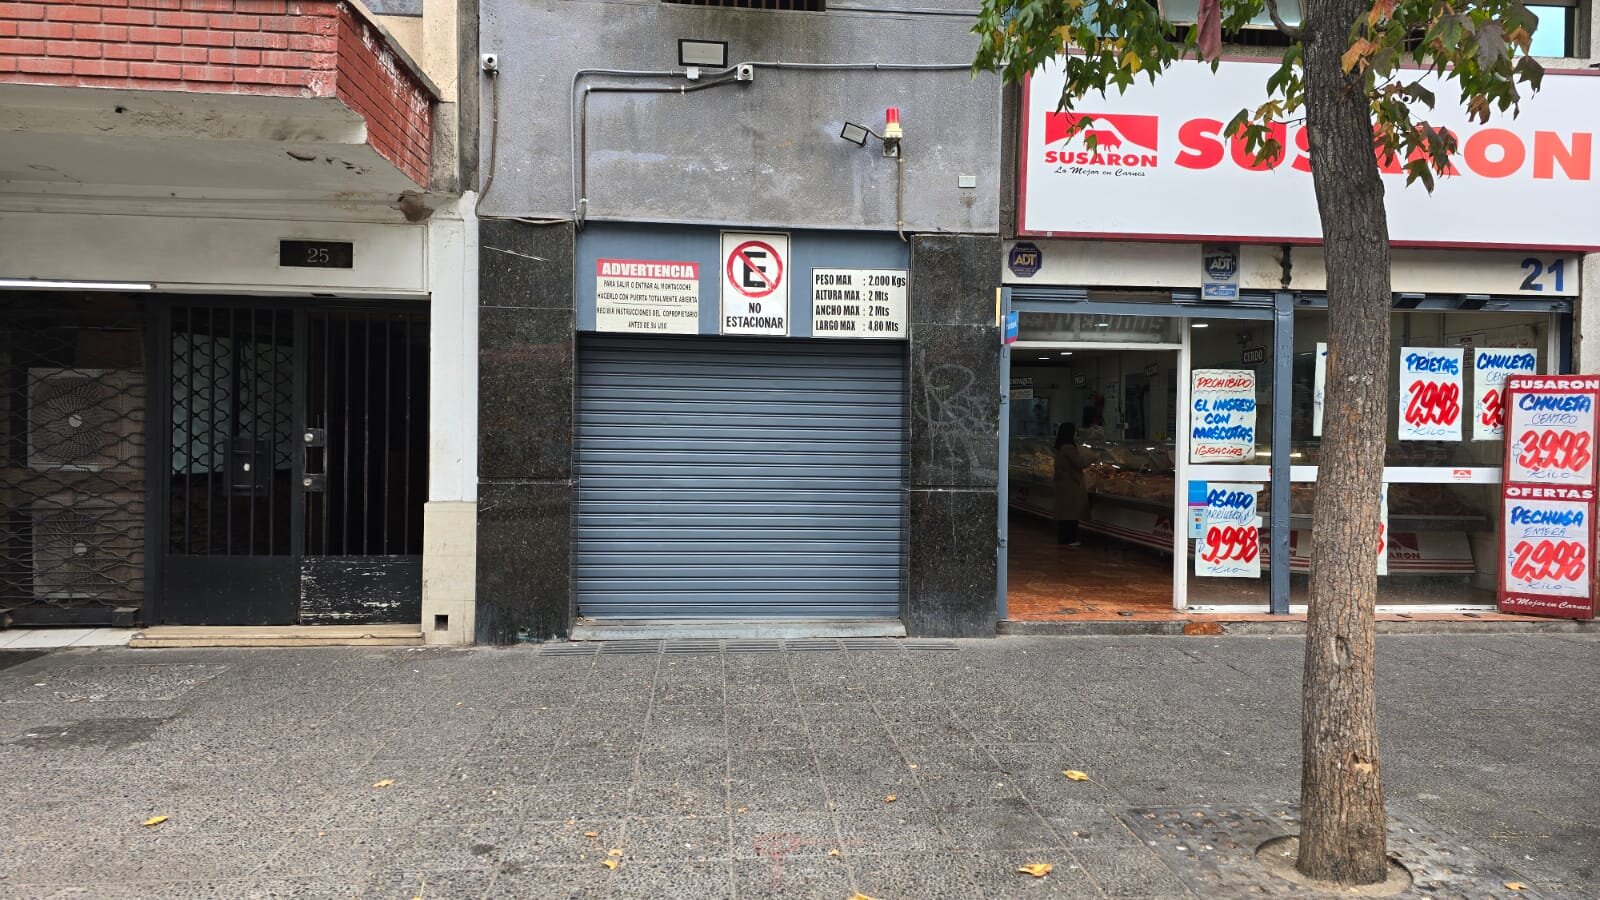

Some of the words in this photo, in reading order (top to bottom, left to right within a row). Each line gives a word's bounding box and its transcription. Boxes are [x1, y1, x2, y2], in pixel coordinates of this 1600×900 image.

[1174, 117, 1592, 180] SUON
[1045, 151, 1157, 167] SUSARON
[1070, 167, 1099, 176] Mejor
[1115, 168, 1145, 177] Carnes
[307, 248, 329, 263] 25
[1014, 253, 1036, 266] ADT
[1210, 257, 1232, 269] ADT
[602, 262, 695, 278] ADVERTENCIA
[1520, 257, 1564, 292] 21
[815, 274, 834, 285] PESO
[836, 275, 852, 286] MAX
[869, 275, 890, 286] 2.000
[891, 275, 906, 288] Kgs
[815, 290, 843, 300] ALTURA
[844, 290, 860, 300] MAX
[868, 290, 873, 300] 2
[874, 290, 889, 301] Mts
[652, 309, 660, 317] DEL
[749, 302, 762, 313] NO
[815, 305, 841, 316] ANCHO
[843, 305, 860, 316] MAX
[868, 306, 873, 316] 2
[875, 306, 890, 316] Mts
[628, 321, 642, 329] ANTES
[726, 316, 784, 329] ESTACIONAR
[815, 320, 838, 331] LARGO
[840, 321, 856, 331] MAX
[885, 321, 899, 332] Mts
[1476, 352, 1536, 372] CHULETA
[1197, 377, 1252, 388] PROHIBIDO
[1510, 380, 1599, 390] SUSARON
[1194, 398, 1210, 412] EL
[1519, 394, 1592, 413] CHULETA
[1204, 412, 1231, 424] CON
[1532, 412, 1578, 425] CENTRO
[1207, 488, 1254, 510] ASADO
[1506, 488, 1594, 499] OFERTAS
[1510, 506, 1584, 528] PECHUGA
[1516, 598, 1546, 608] Mejor
[1558, 602, 1592, 610] Carnes
